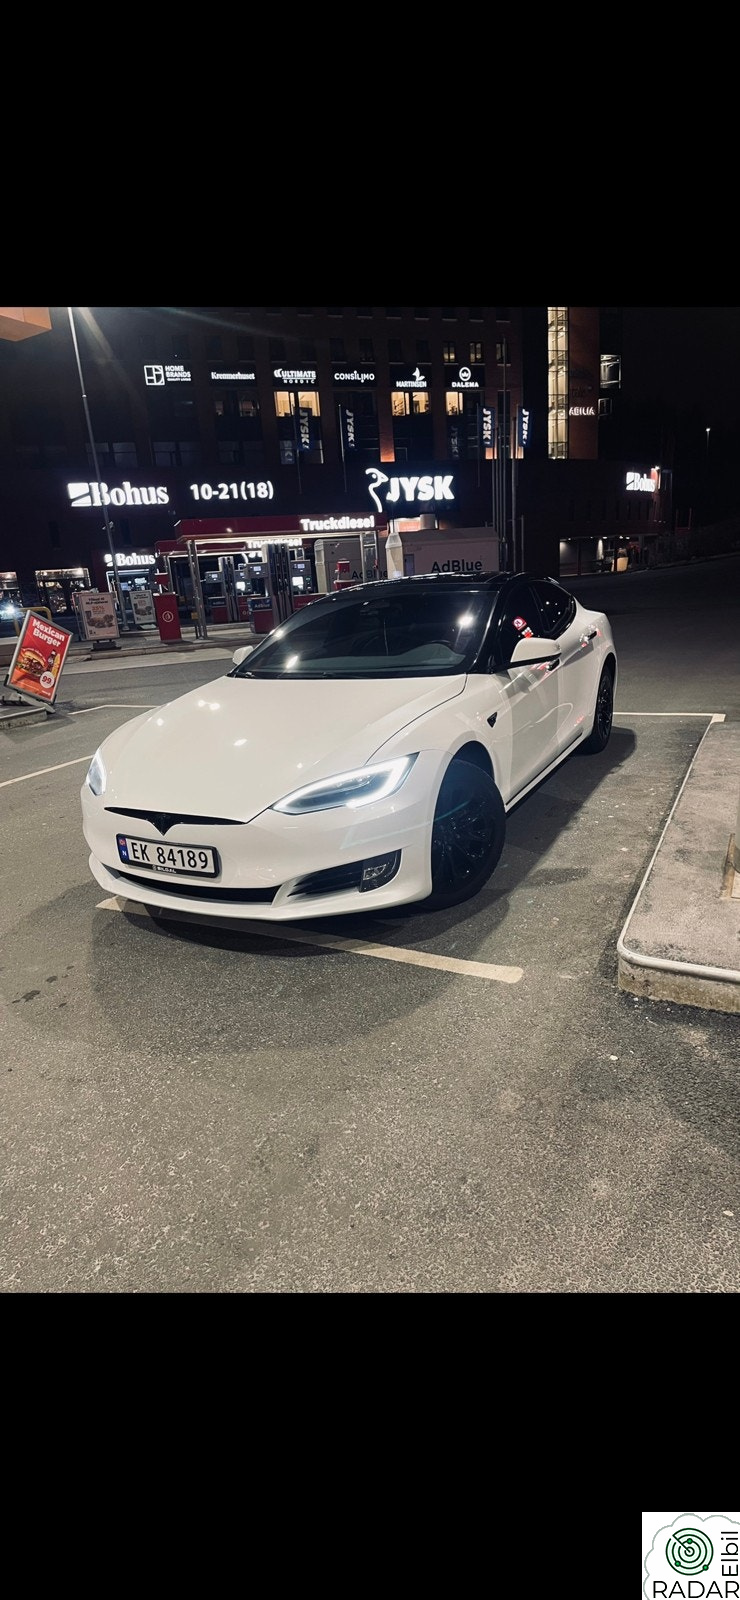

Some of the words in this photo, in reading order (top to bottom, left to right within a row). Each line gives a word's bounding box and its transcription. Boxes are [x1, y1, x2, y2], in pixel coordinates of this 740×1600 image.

[281, 370, 316, 379] ULTIMATE
[396, 380, 427, 388] MARTINSEN
[568, 406, 596, 416] ABILIA
[89, 481, 169, 507] Bohus
[190, 480, 274, 501] 10-21(18)
[387, 475, 455, 503] JYSK
[300, 515, 375, 532] Truckdiesel
[115, 552, 156, 567] Bohus
[431, 559, 483, 573] AdBlue
[32, 618, 65, 642] Mexican
[33, 628, 61, 647] Burger
[131, 842, 150, 862] EK
[156, 846, 208, 869] 84189
